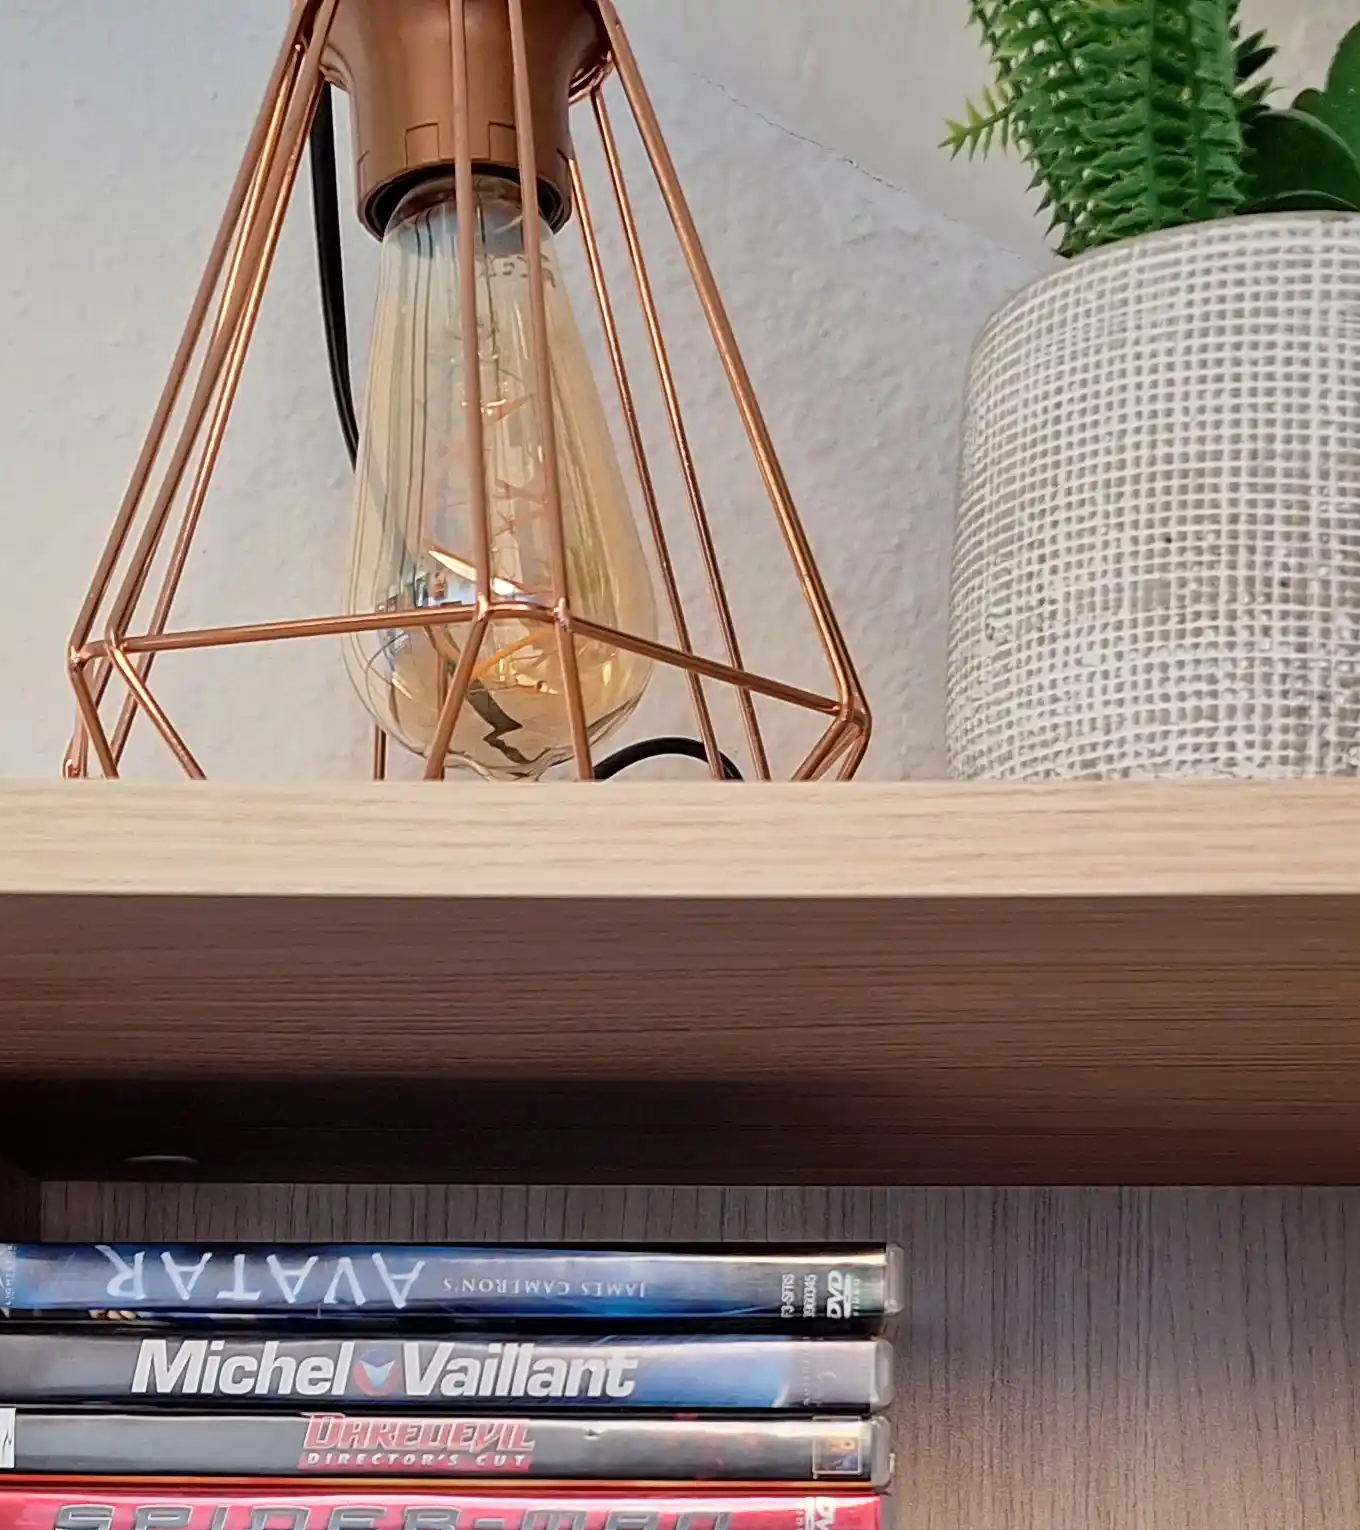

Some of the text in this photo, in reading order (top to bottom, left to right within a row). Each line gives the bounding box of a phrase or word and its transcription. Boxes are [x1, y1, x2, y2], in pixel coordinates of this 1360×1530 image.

[93, 1244, 426, 1309] AVATAR
[442, 1275, 646, 1299] JAMES CAMERON'S
[131, 1339, 640, 1399] Michel Vaillant
[302, 1412, 536, 1451] DAREDEVIL
[307, 1452, 527, 1468] DIRECTOR'S CUT
